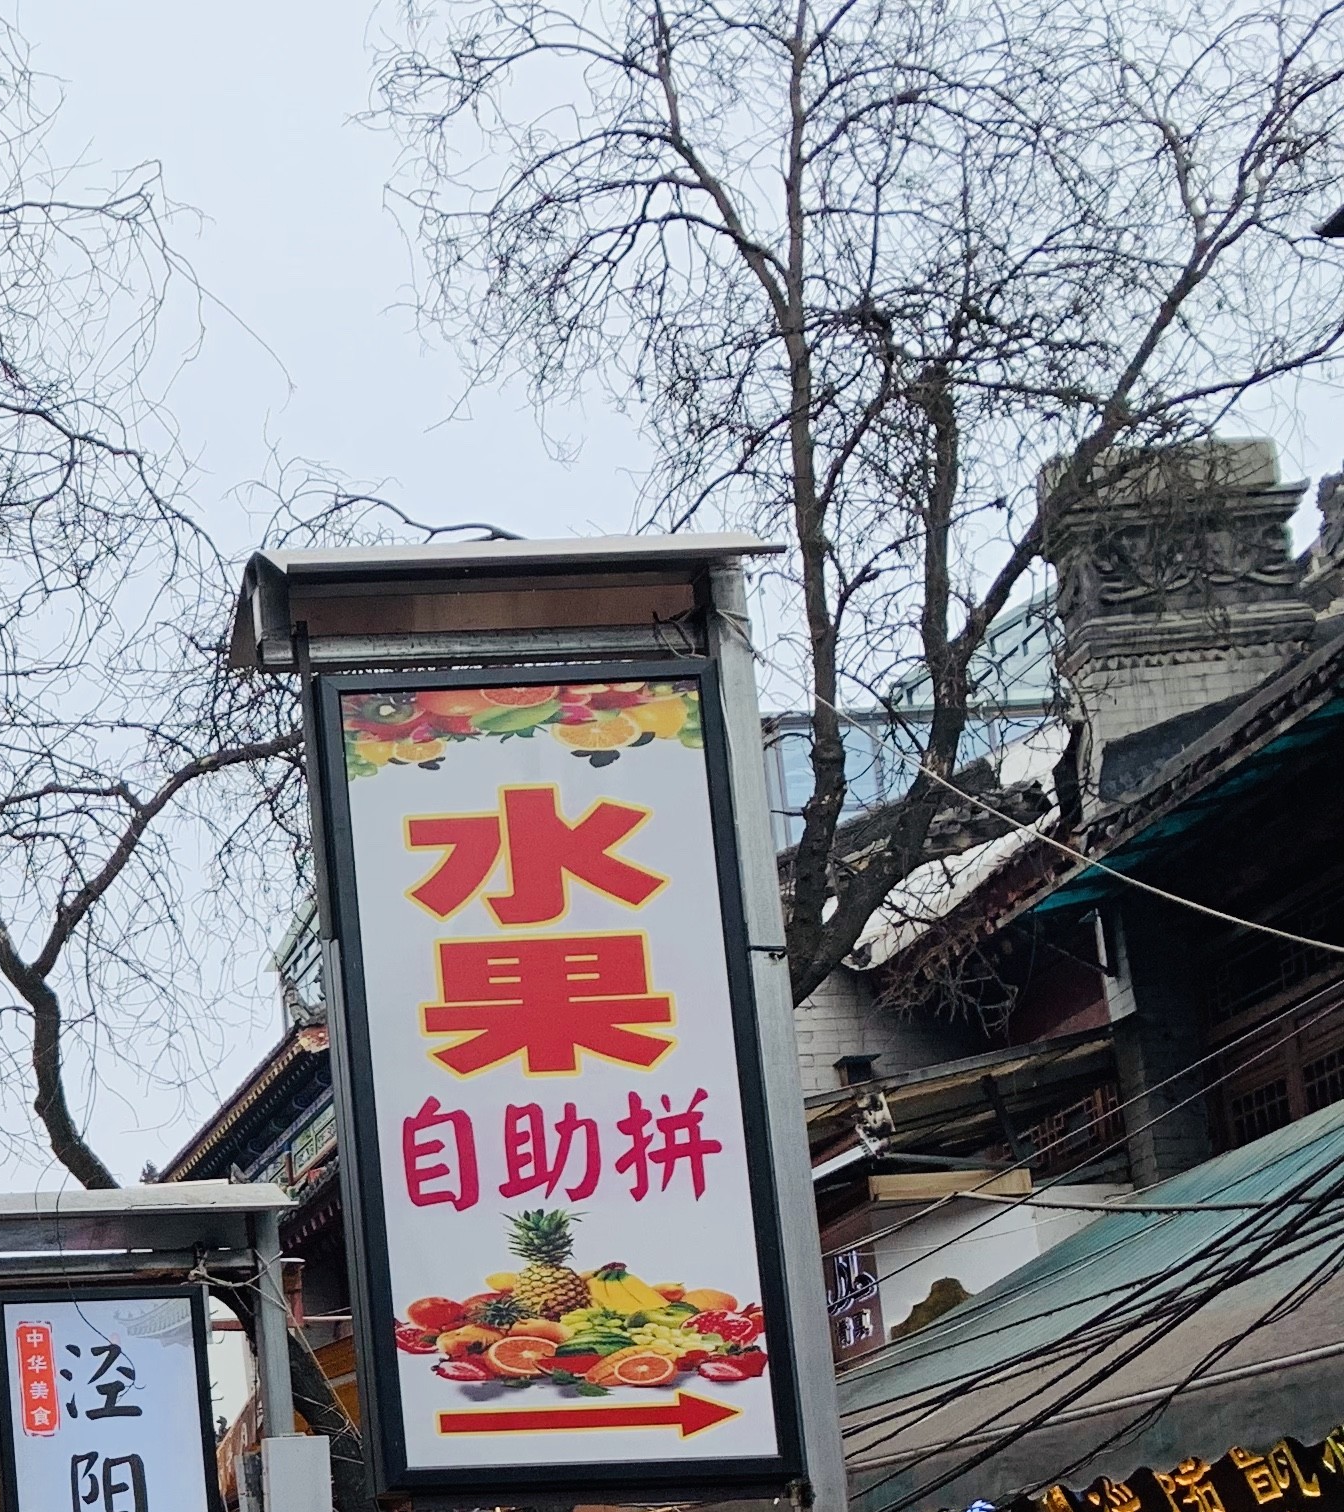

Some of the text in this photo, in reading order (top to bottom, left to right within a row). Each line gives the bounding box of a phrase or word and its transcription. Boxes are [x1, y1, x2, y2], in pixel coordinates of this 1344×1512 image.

[405, 782, 674, 1077] 水果
[400, 1087, 723, 1212] 自助拼
[25, 1328, 51, 1427] 中华美食
